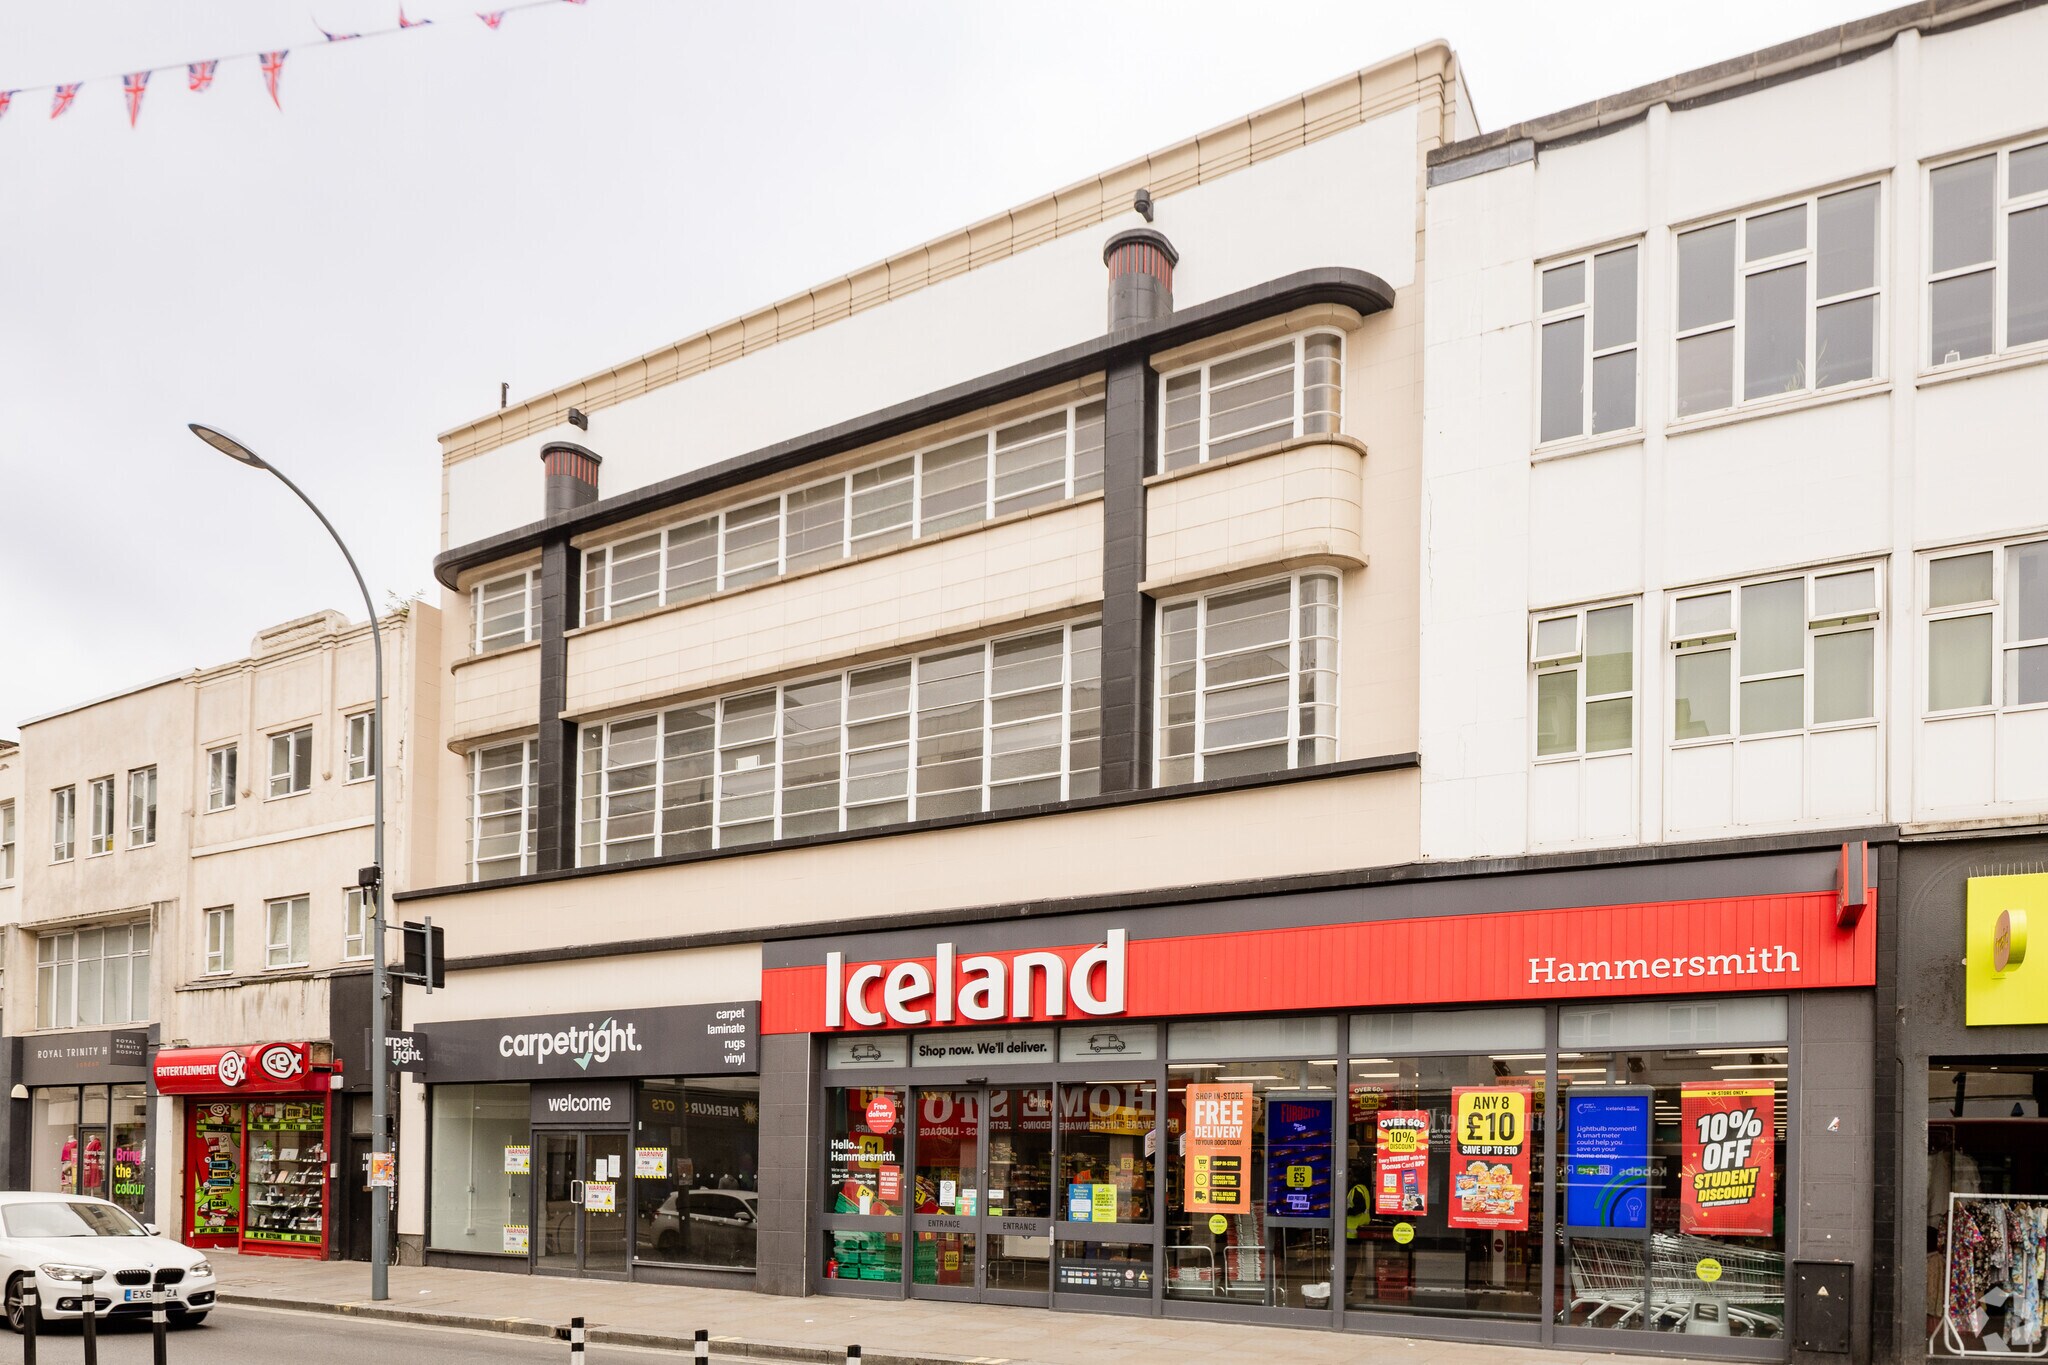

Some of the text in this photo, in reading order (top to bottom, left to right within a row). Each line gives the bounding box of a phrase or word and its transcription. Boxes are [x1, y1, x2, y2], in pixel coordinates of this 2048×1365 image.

[1528, 946, 1800, 984] Hammersmith
[825, 928, 1127, 1027] Iceland
[716, 1008, 745, 1020] carpet
[707, 1023, 745, 1034] laminate
[374, 1037, 414, 1050] rpet
[725, 1040, 745, 1050] rugs
[919, 1041, 1047, 1058] Shop now. We'll deliver.
[38, 1049, 62, 1058] ROYAL
[67, 1047, 98, 1057] TRINITY
[724, 1053, 745, 1065] vinyl
[157, 1065, 217, 1076] ENTERTAINMENT
[548, 1093, 611, 1112] welcome
[1473, 1096, 1509, 1110] ANY 8
[288, 1108, 301, 1117] STUFF
[313, 1107, 324, 1117] CAS
[1195, 1101, 1243, 1125] FREE
[1380, 1119, 1425, 1128] OVER 60s
[1467, 1112, 1515, 1141] £10
[1698, 1109, 1762, 1143] 10%
[1195, 1125, 1242, 1138] DELIVERY
[1390, 1131, 1415, 1143] 10%
[116, 1147, 141, 1166] Bring
[831, 1151, 895, 1161] Hammersmith
[1462, 1146, 1517, 1155] SAVE UP TO £10
[1703, 1139, 1751, 1171] OFF
[115, 1164, 131, 1178] the
[1294, 1173, 1305, 1183] £5
[1694, 1168, 1759, 1189] STUDENT
[115, 1180, 145, 1195] colour
[1698, 1185, 1755, 1202] DISCOUNT
[928, 1220, 960, 1228] ENTRANCE
[1003, 1222, 1036, 1231] ENTRANCE
[946, 1254, 958, 1263] SAVE
[133, 1289, 178, 1299] EX6 ZA
